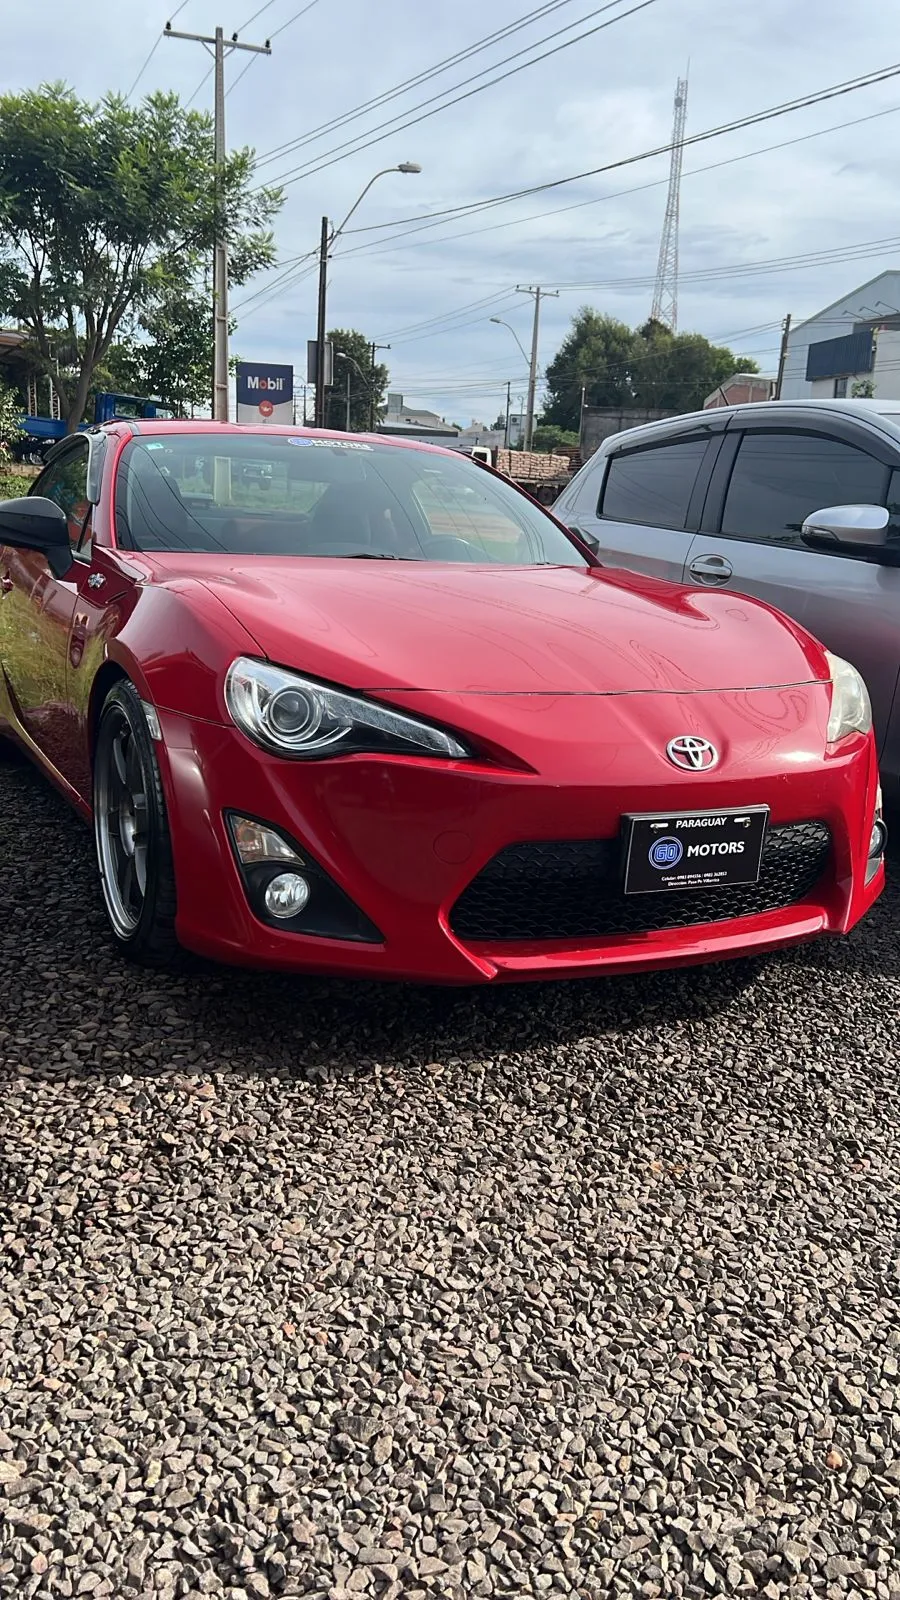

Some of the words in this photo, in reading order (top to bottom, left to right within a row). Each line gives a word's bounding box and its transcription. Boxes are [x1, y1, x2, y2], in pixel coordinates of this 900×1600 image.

[247, 375, 284, 391] Mobil
[675, 817, 727, 828] PARAGUAY
[654, 844, 678, 862] GO
[687, 841, 745, 857] MOTORS
